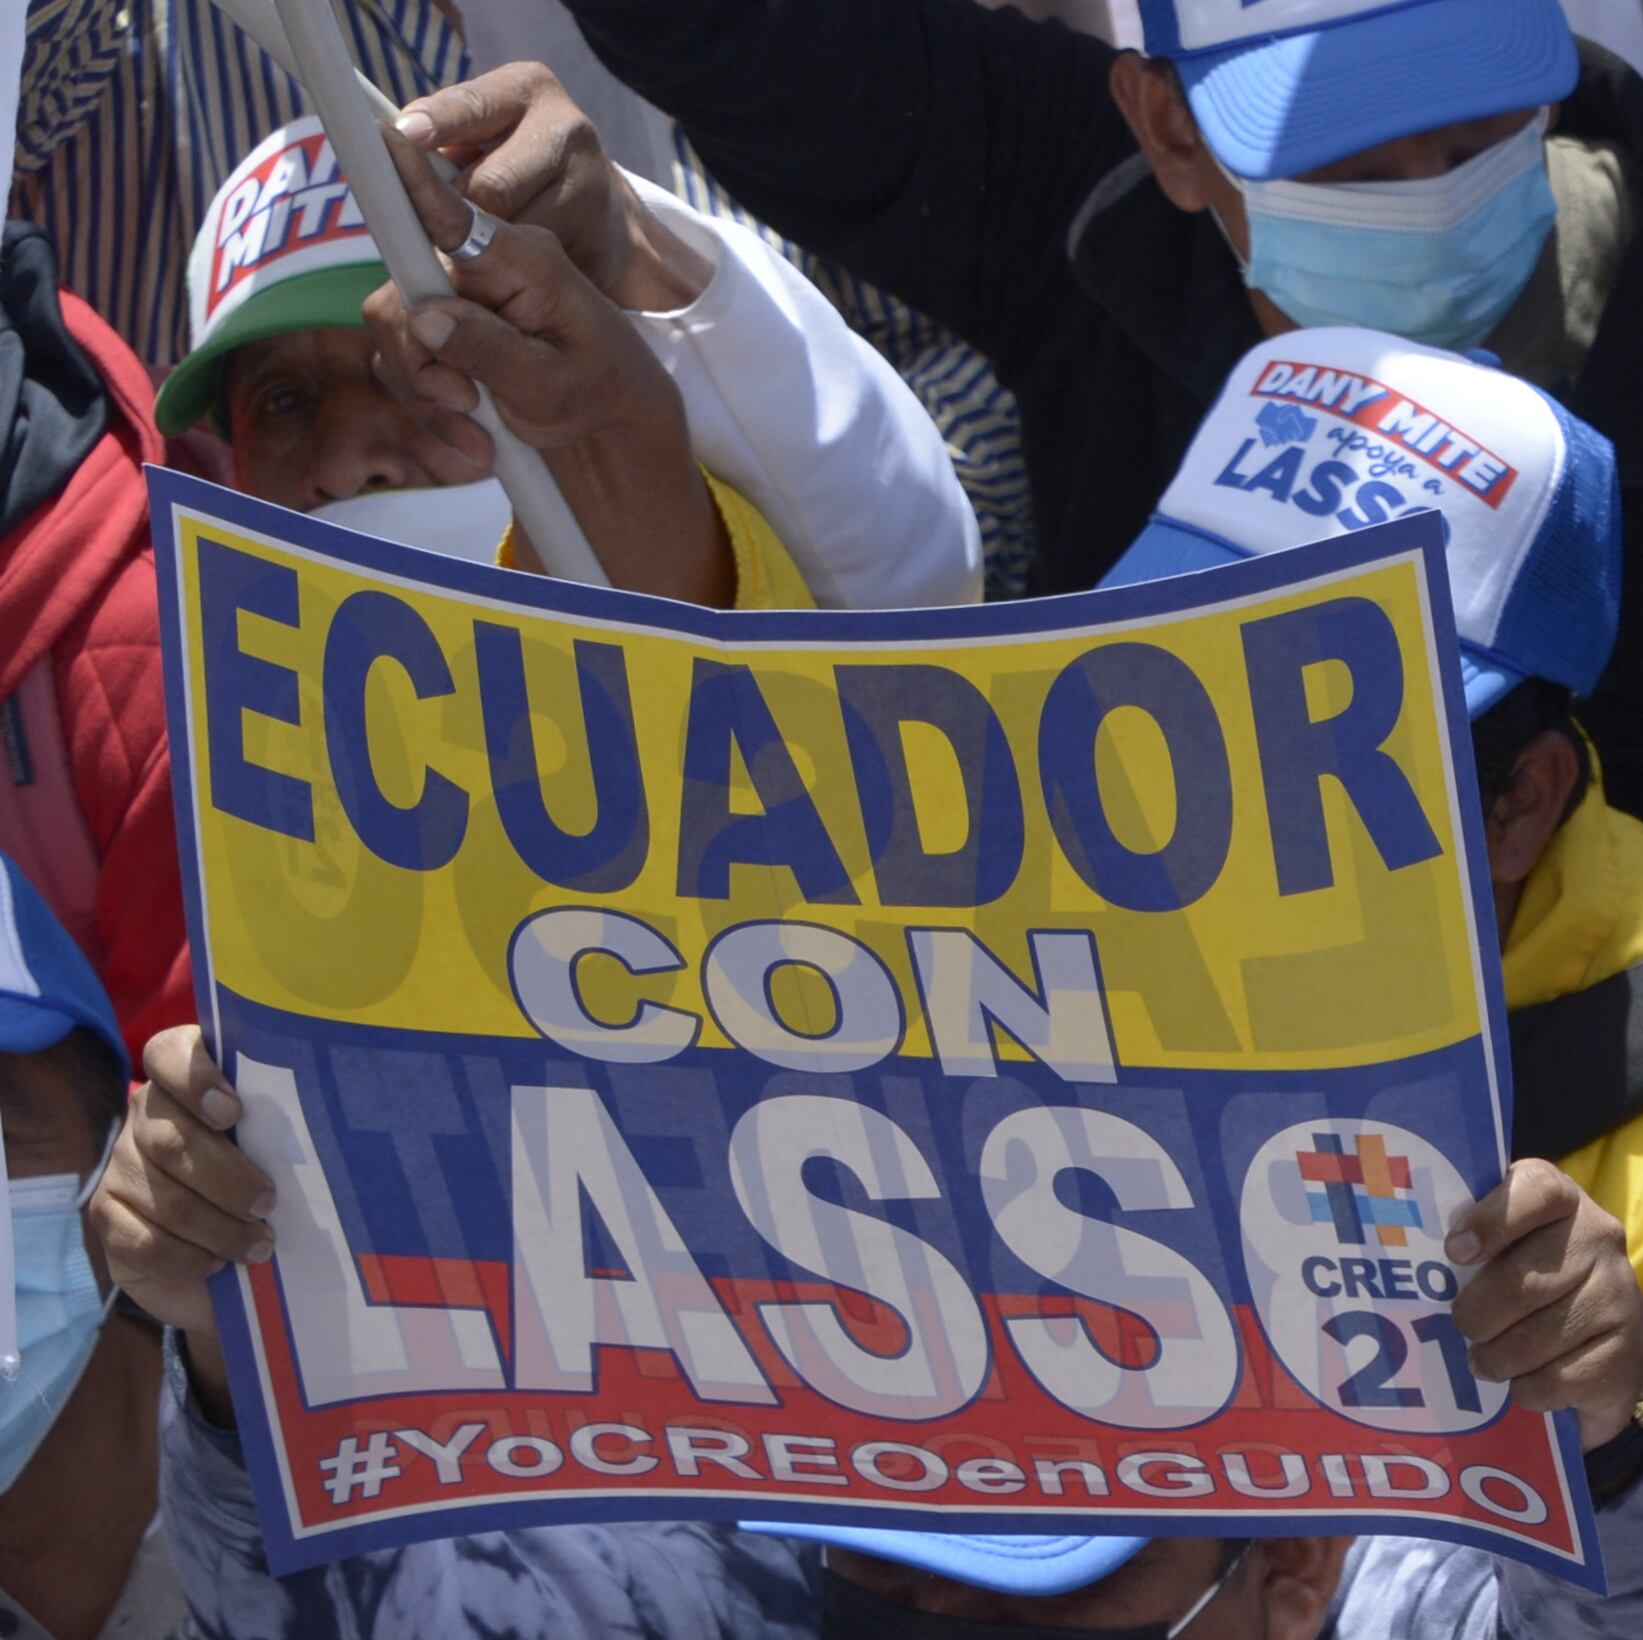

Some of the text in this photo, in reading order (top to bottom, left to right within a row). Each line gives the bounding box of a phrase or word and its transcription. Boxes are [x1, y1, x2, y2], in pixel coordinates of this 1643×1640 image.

[1256, 362, 1510, 498] DANY MITE
[1326, 426, 1446, 496] apoya a
[1212, 437, 1451, 549] LASS
[194, 535, 1444, 913] ECUADOR
[507, 904, 1120, 1084] CON
[235, 1050, 1513, 1435] LASSO
[1301, 1256, 1459, 1302] CREO
[1321, 1310, 1483, 1415] 21
[319, 1422, 1549, 1526] #YoCREOenGUIDO
